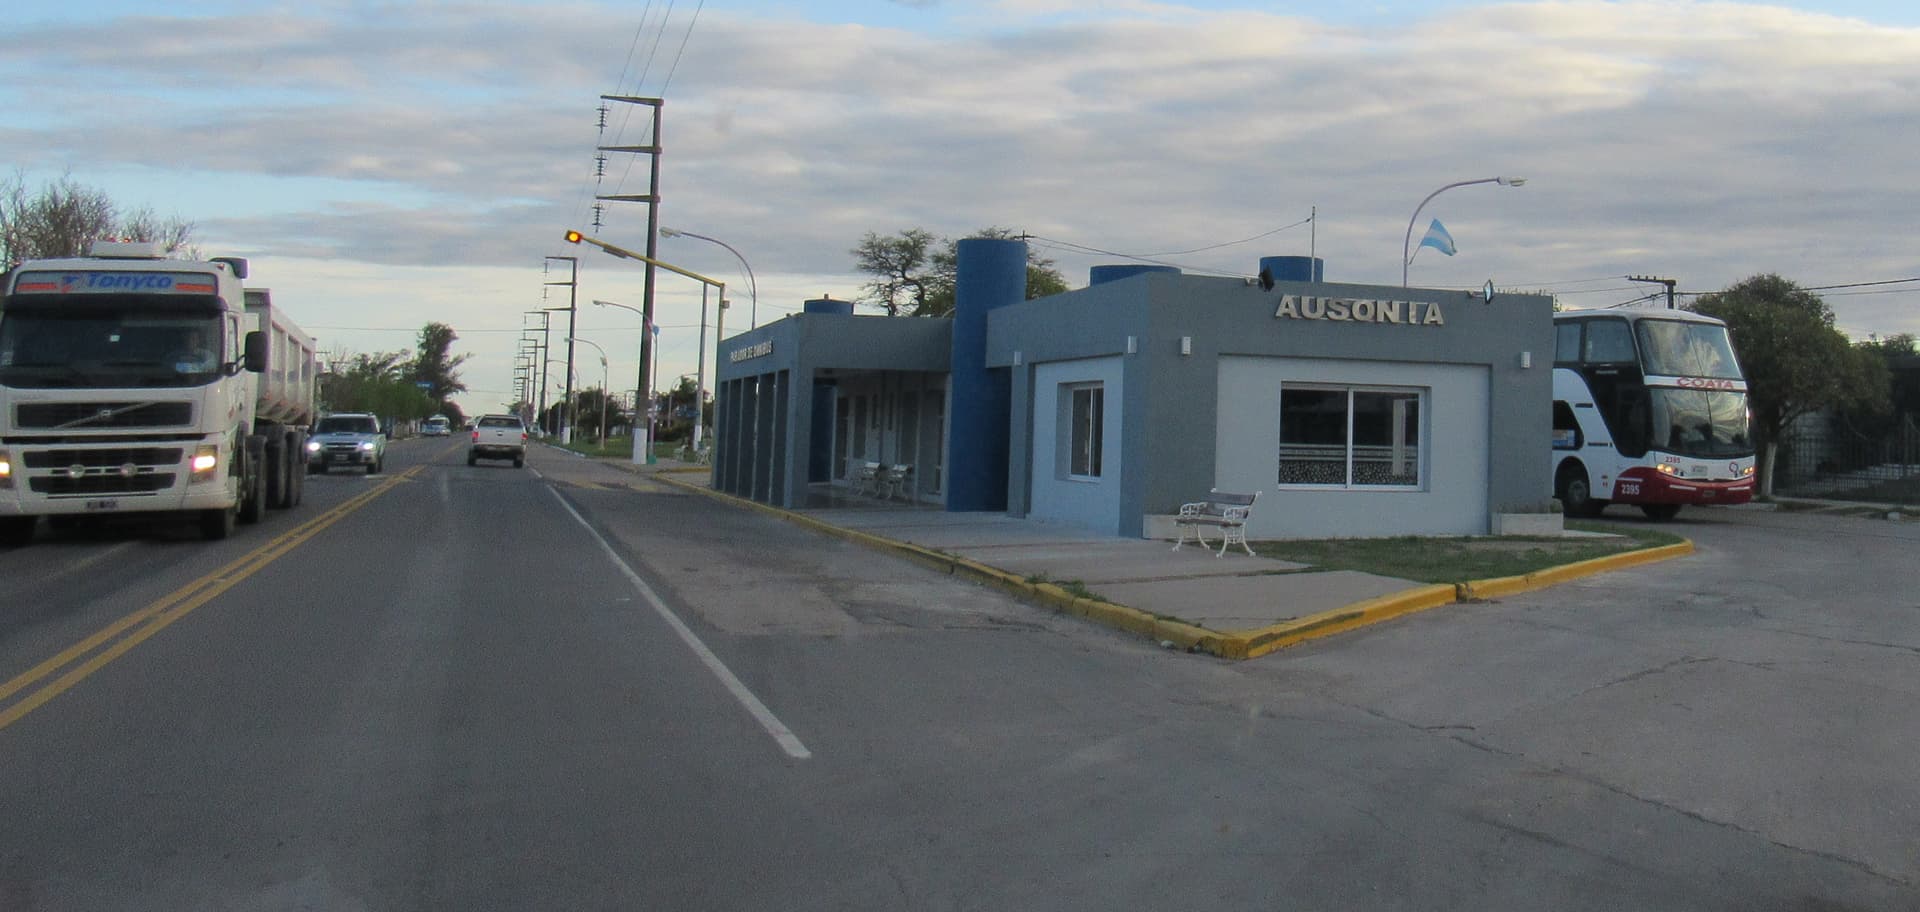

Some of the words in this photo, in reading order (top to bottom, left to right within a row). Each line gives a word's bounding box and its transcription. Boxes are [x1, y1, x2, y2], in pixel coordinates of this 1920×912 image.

[87, 272, 173, 289] Tonyto
[1275, 294, 1444, 325] AUSONIA
[1677, 376, 1734, 389] COATA
[1621, 484, 1640, 495] 2395
